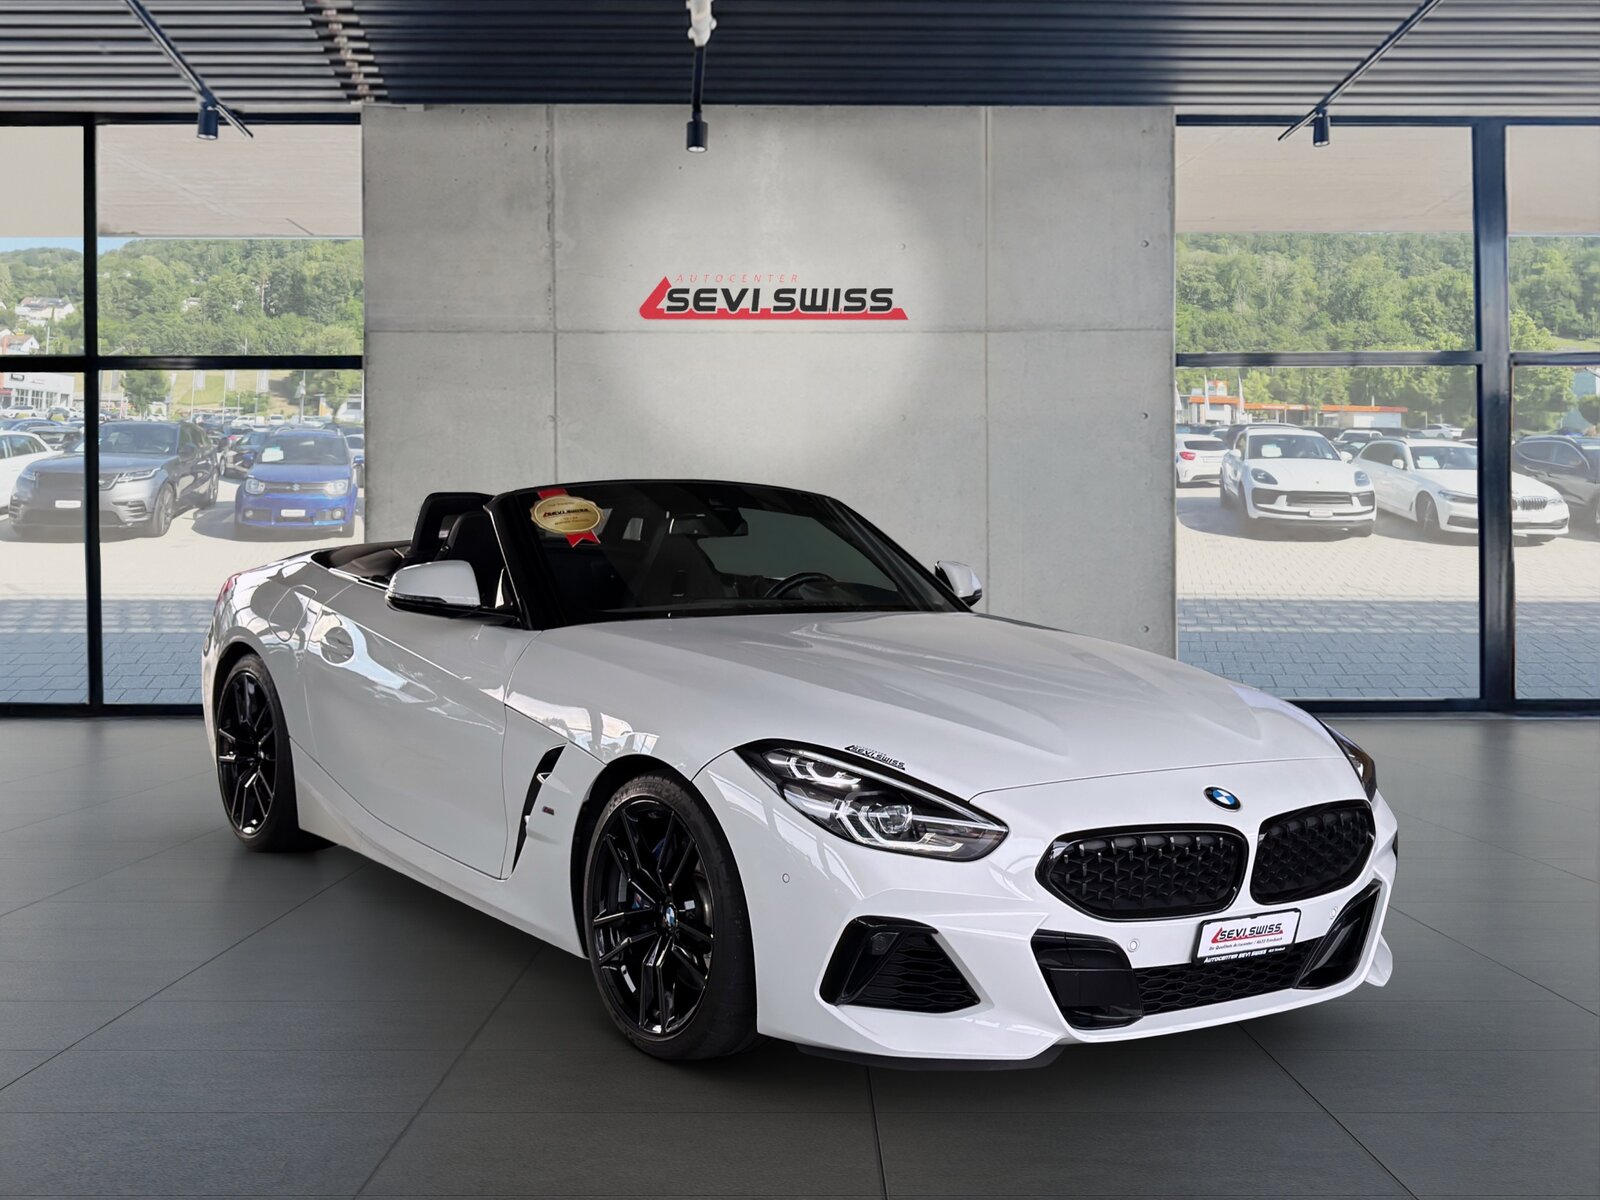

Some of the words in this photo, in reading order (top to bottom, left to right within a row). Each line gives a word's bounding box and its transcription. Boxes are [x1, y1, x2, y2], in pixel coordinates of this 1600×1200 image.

[675, 273, 798, 283] AUTOCENTER
[665, 287, 761, 313] SEVI
[772, 287, 894, 313] SWISS
[876, 754, 904, 768] SWISS
[1219, 928, 1247, 939] SEVI
[1249, 923, 1282, 935] SWISS
